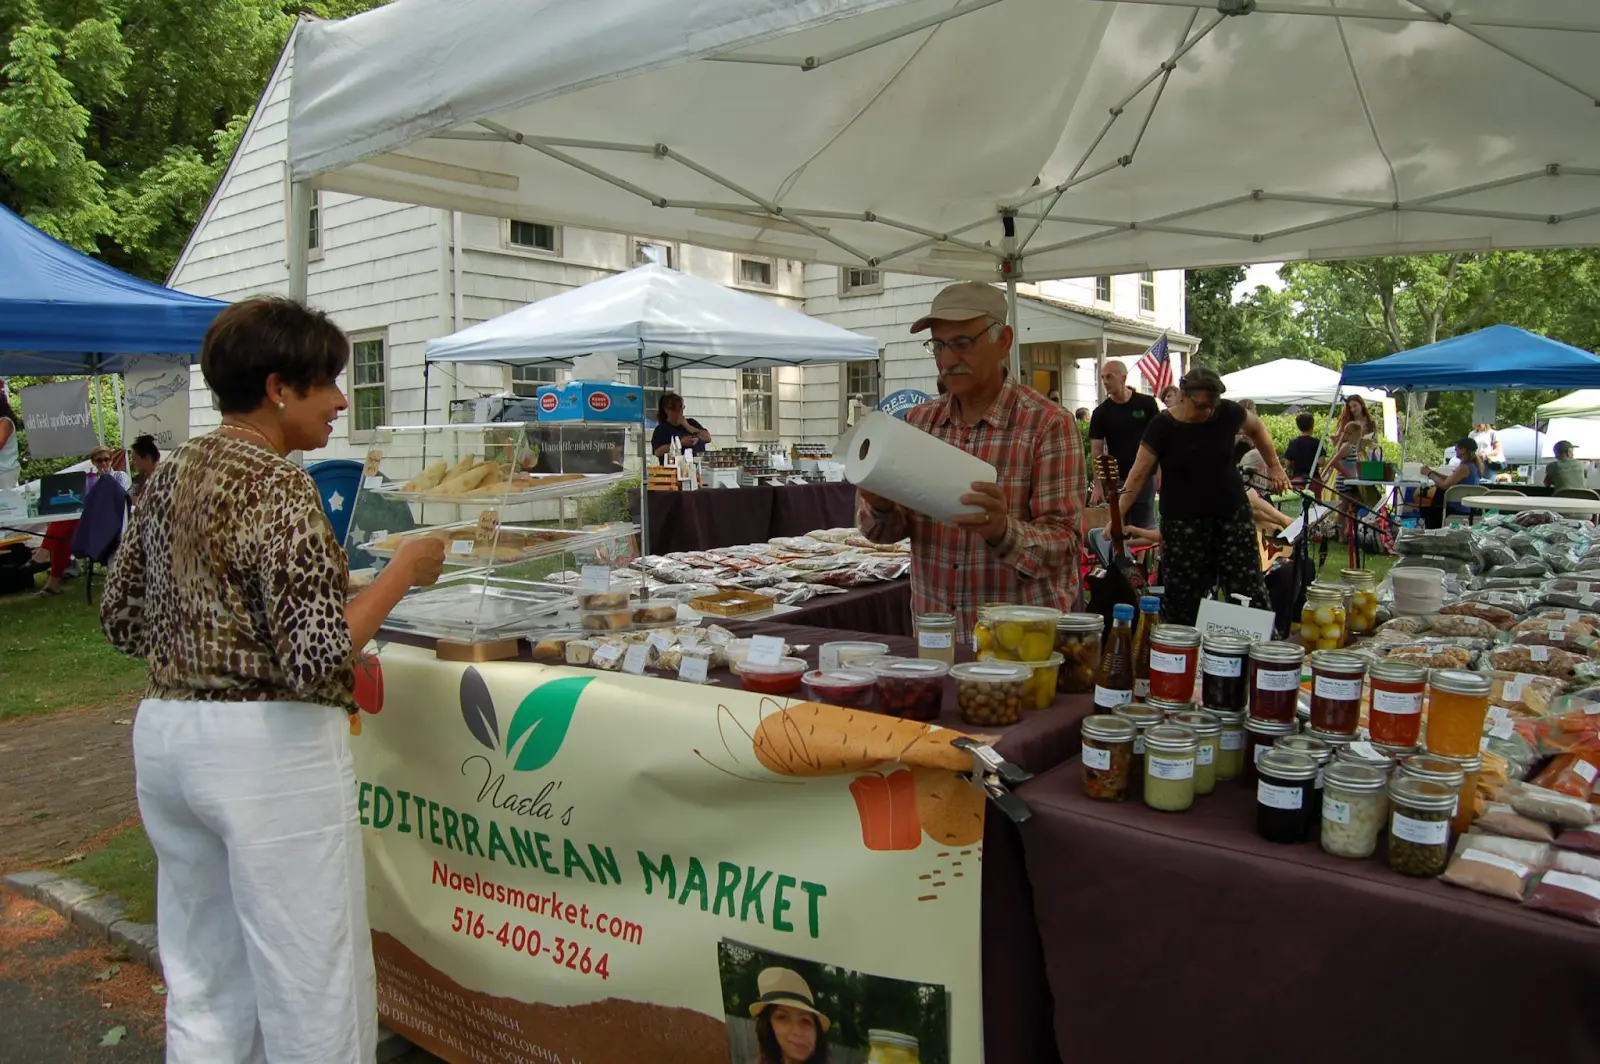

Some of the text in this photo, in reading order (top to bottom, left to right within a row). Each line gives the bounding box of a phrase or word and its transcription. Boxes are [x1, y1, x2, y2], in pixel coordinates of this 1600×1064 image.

[882, 394, 907, 414] REE
[138, 429, 173, 445] SFOOD
[541, 440, 615, 453] Hand Blended Spices
[461, 755, 574, 826] Naela's
[355, 780, 827, 938] EDITERRANEAN MARKET
[431, 860, 643, 945] Naelasmarket.com
[451, 907, 610, 980] 516-400-3264
[386, 984, 412, 1009] TEAS,
[472, 1001, 524, 1035] LABNEH,
